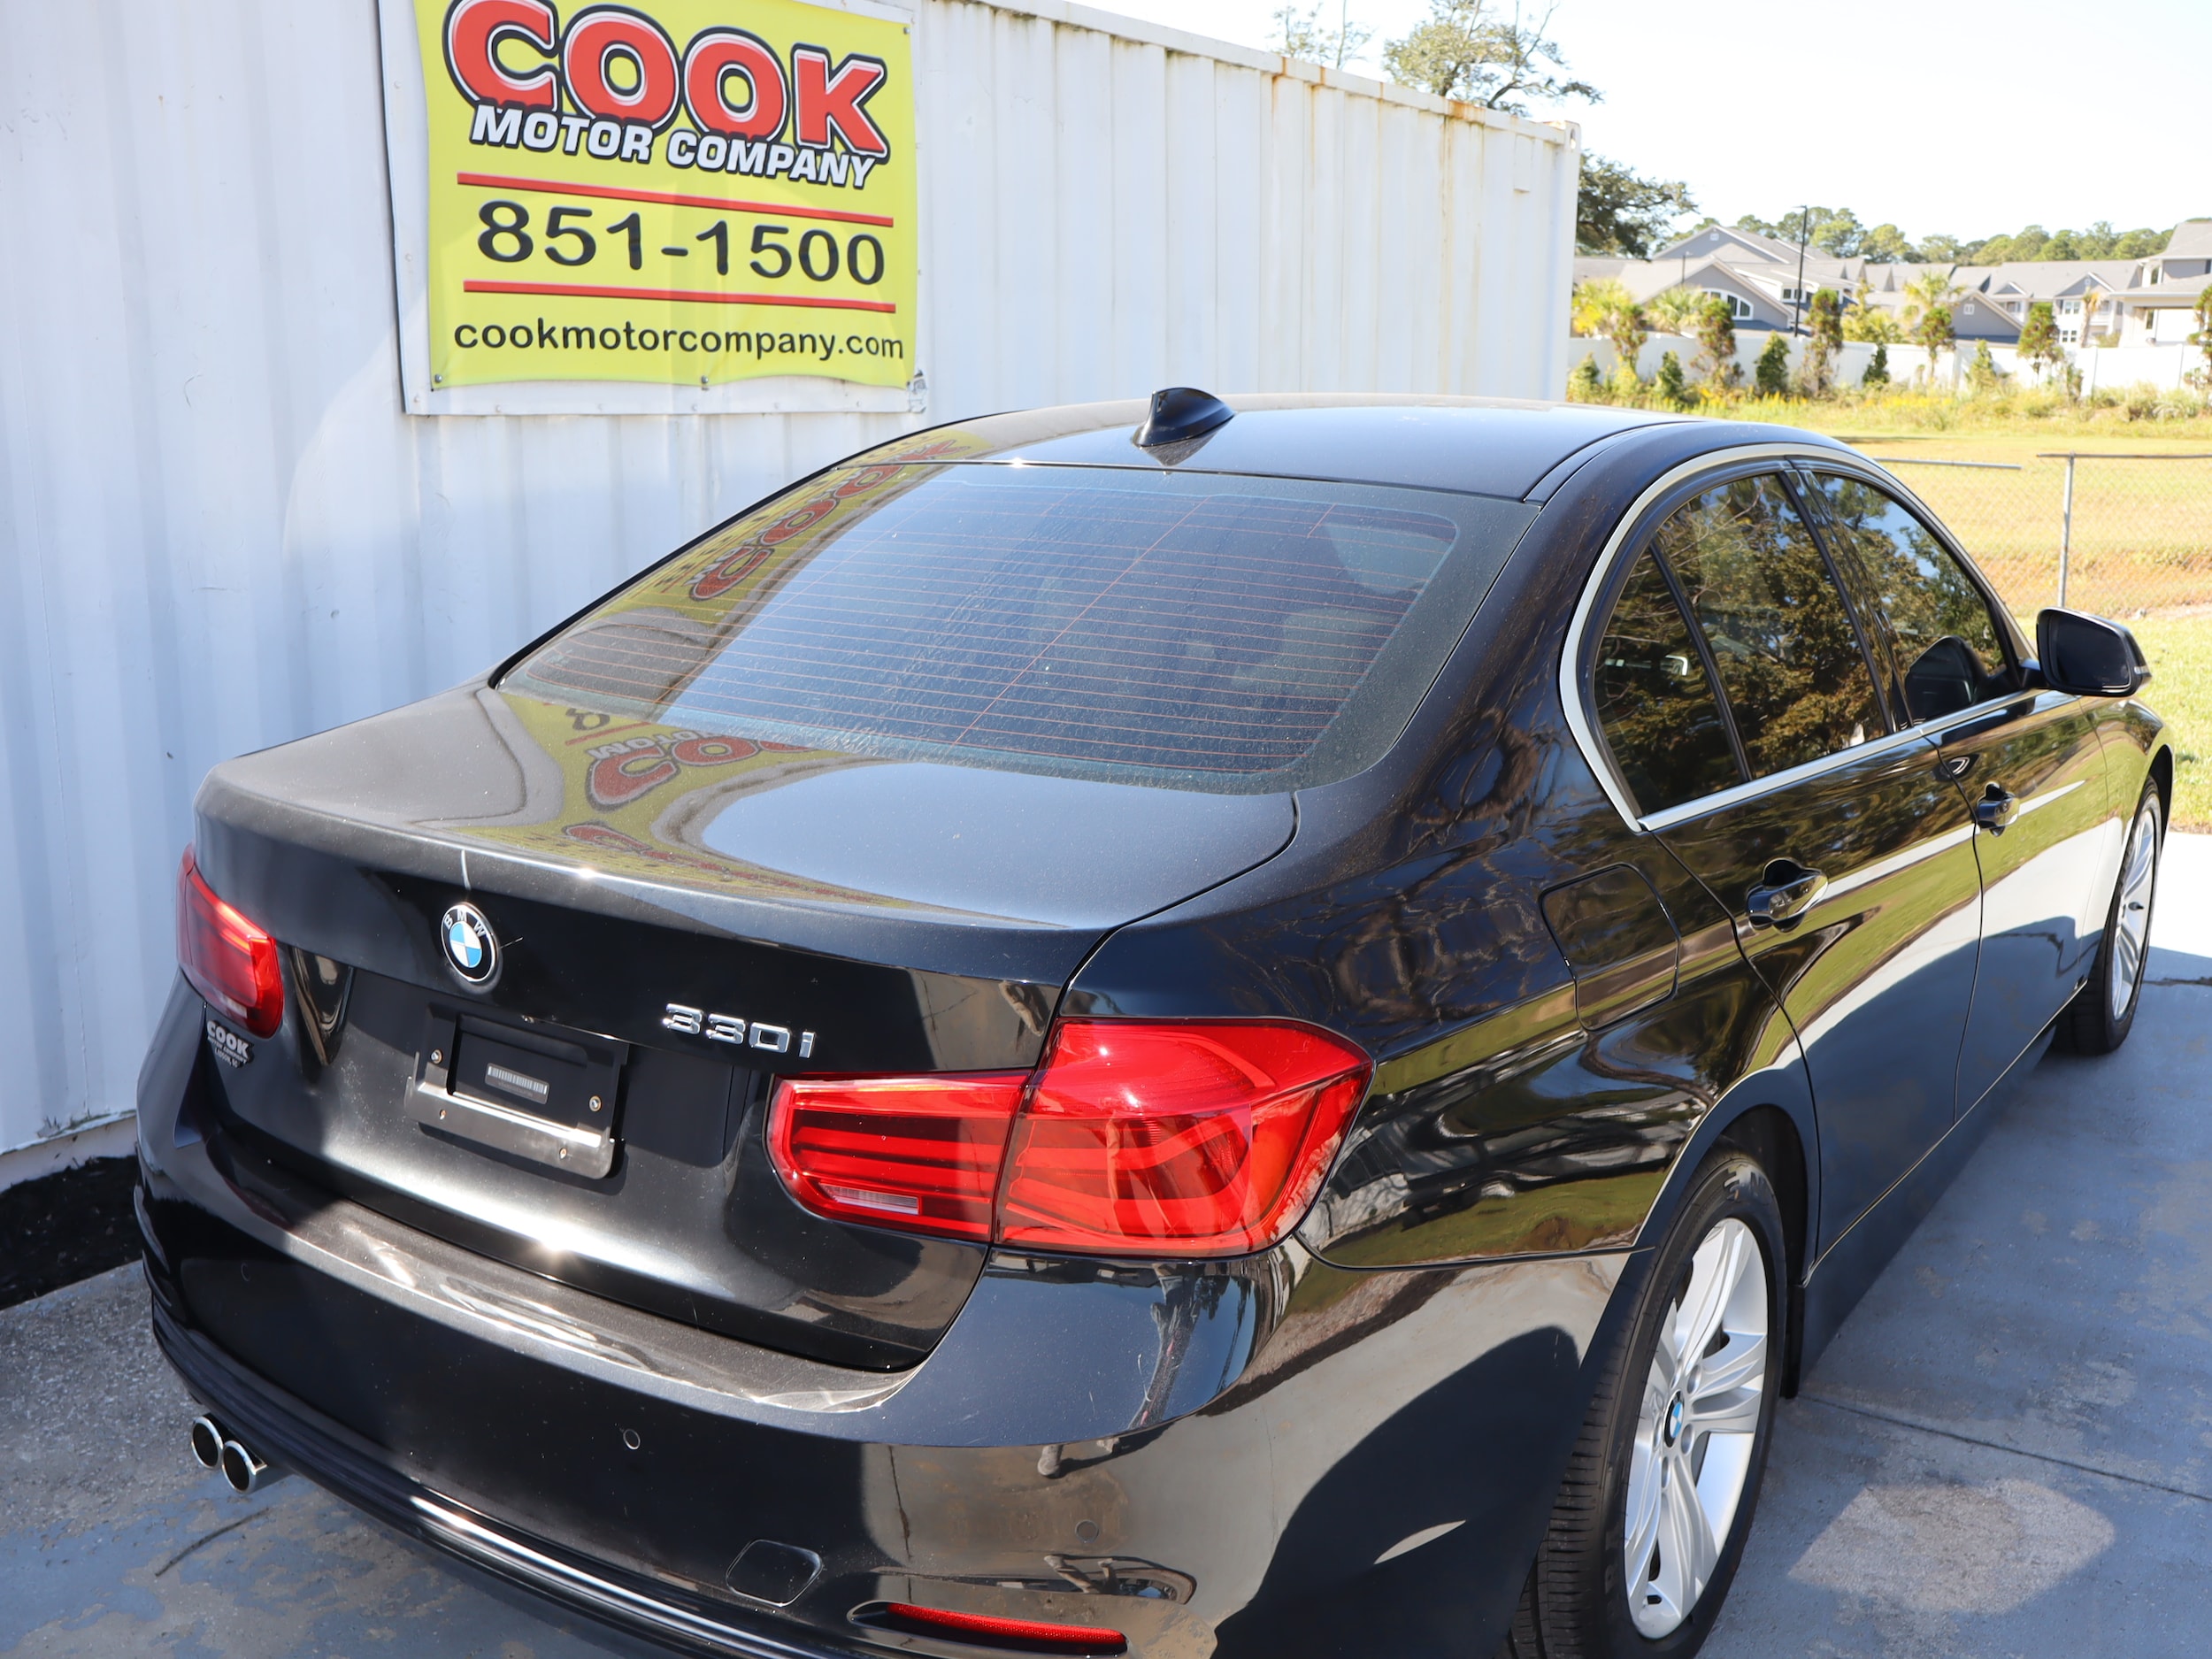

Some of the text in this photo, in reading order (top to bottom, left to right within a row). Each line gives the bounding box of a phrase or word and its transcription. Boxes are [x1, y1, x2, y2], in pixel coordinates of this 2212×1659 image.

[444, 0, 888, 162] COOK
[470, 104, 877, 188] MOTOR COMPANY
[478, 200, 885, 285] 851-1500
[454, 318, 904, 360] cookmotorcompany.com
[443, 909, 487, 938] BMW
[206, 1020, 249, 1060] COOK
[664, 1003, 816, 1059] 330i
